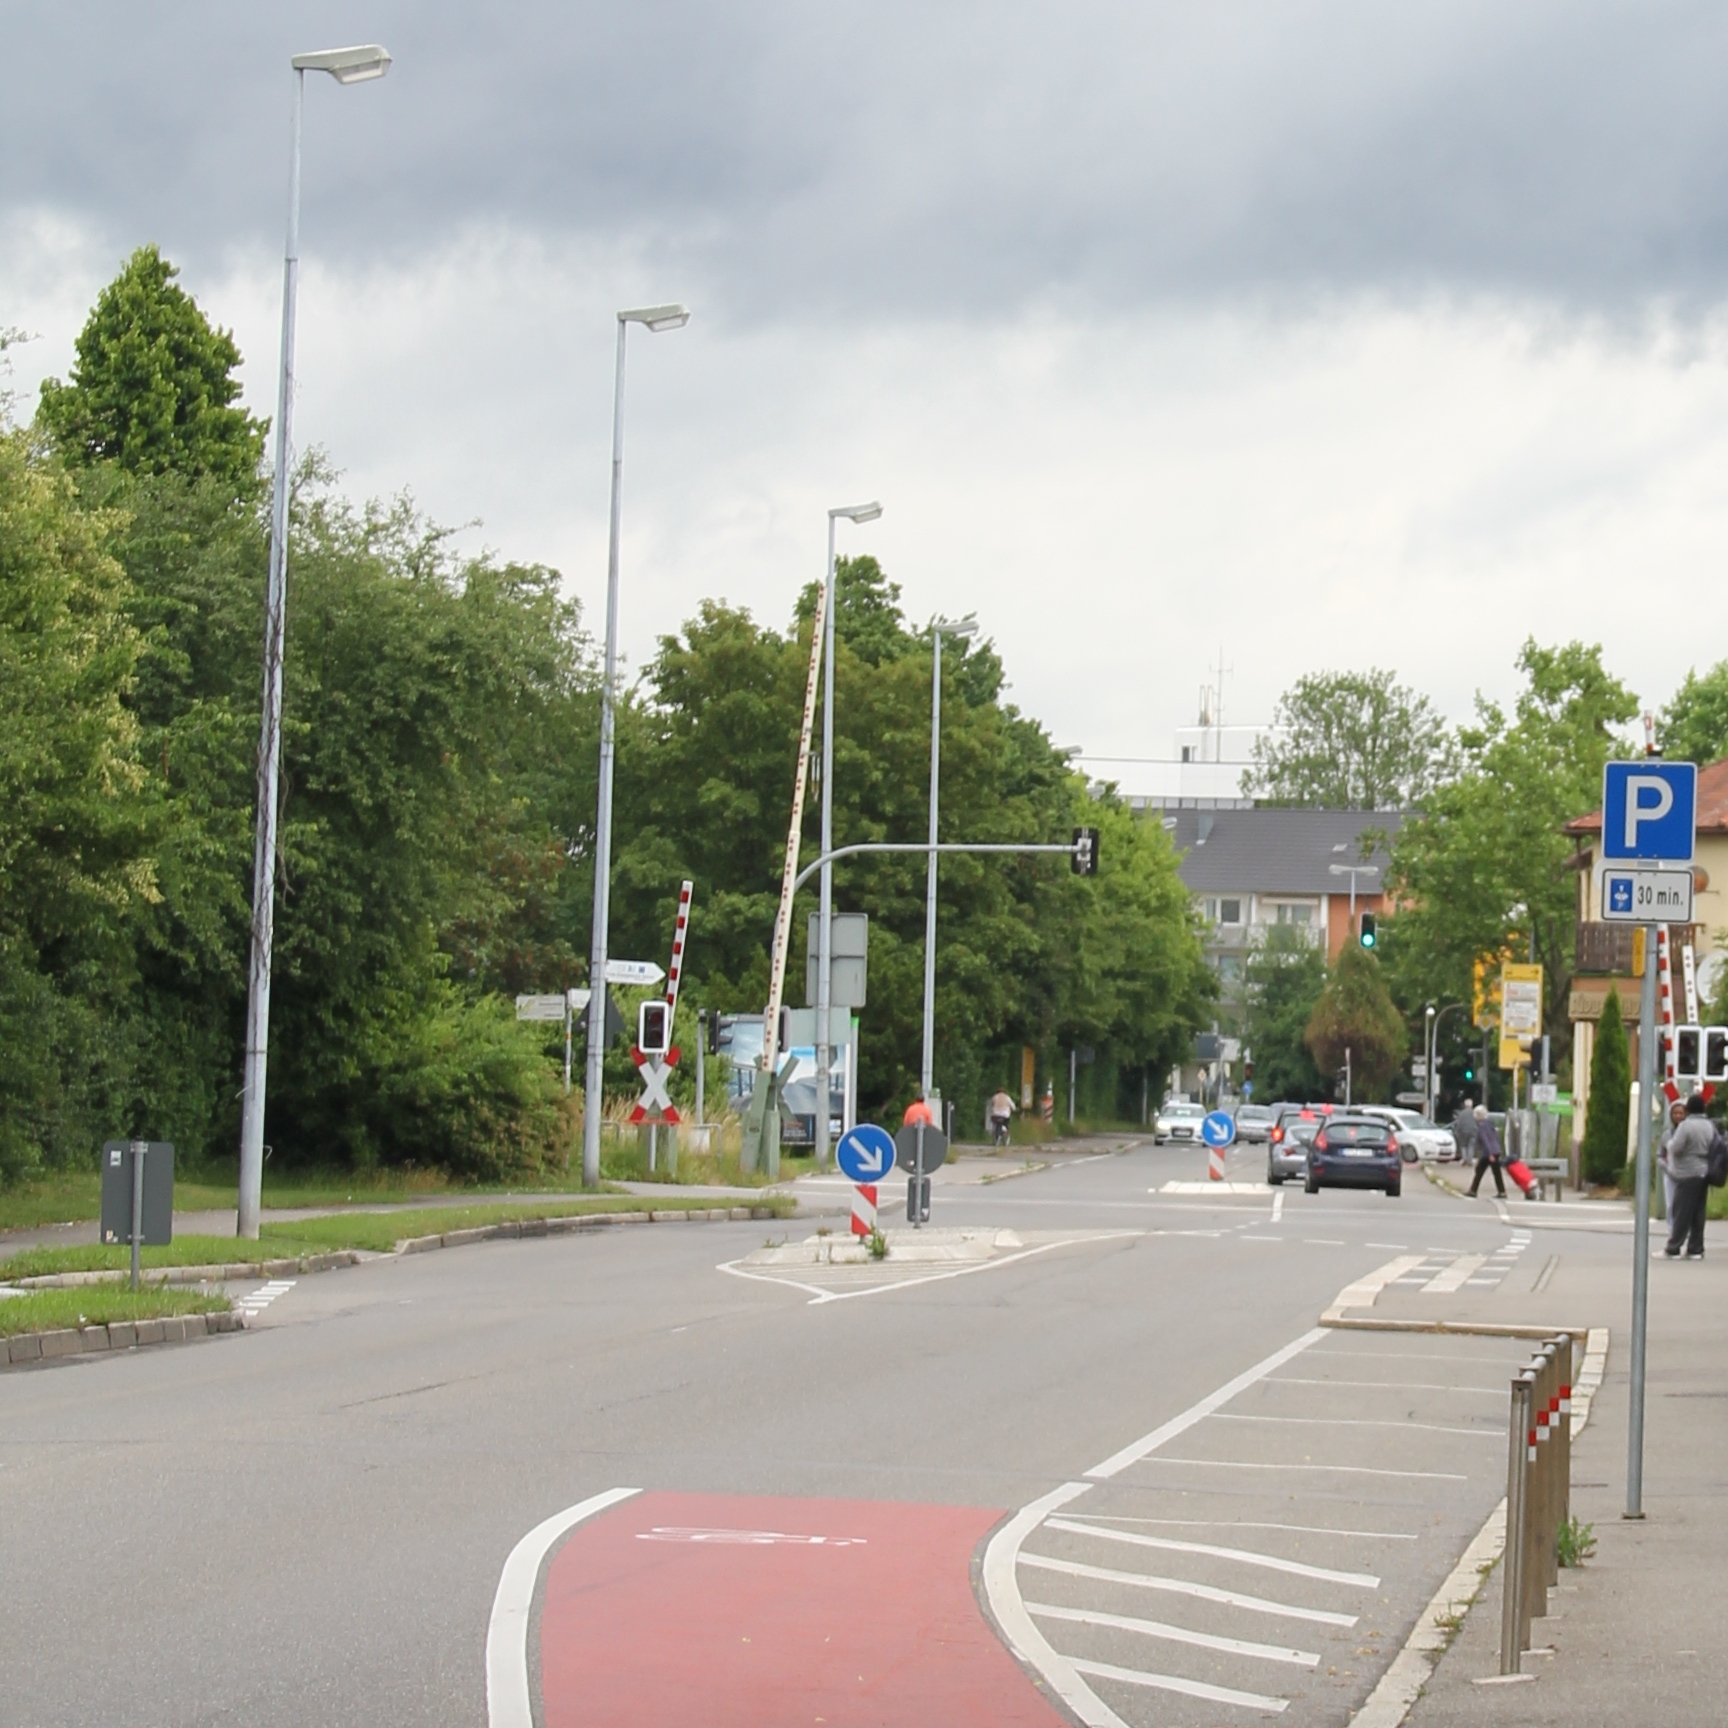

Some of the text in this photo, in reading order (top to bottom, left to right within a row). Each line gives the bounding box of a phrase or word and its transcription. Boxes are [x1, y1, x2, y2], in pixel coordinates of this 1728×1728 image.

[1624, 775, 1674, 848] P
[1637, 885, 1684, 906] 30 min.
